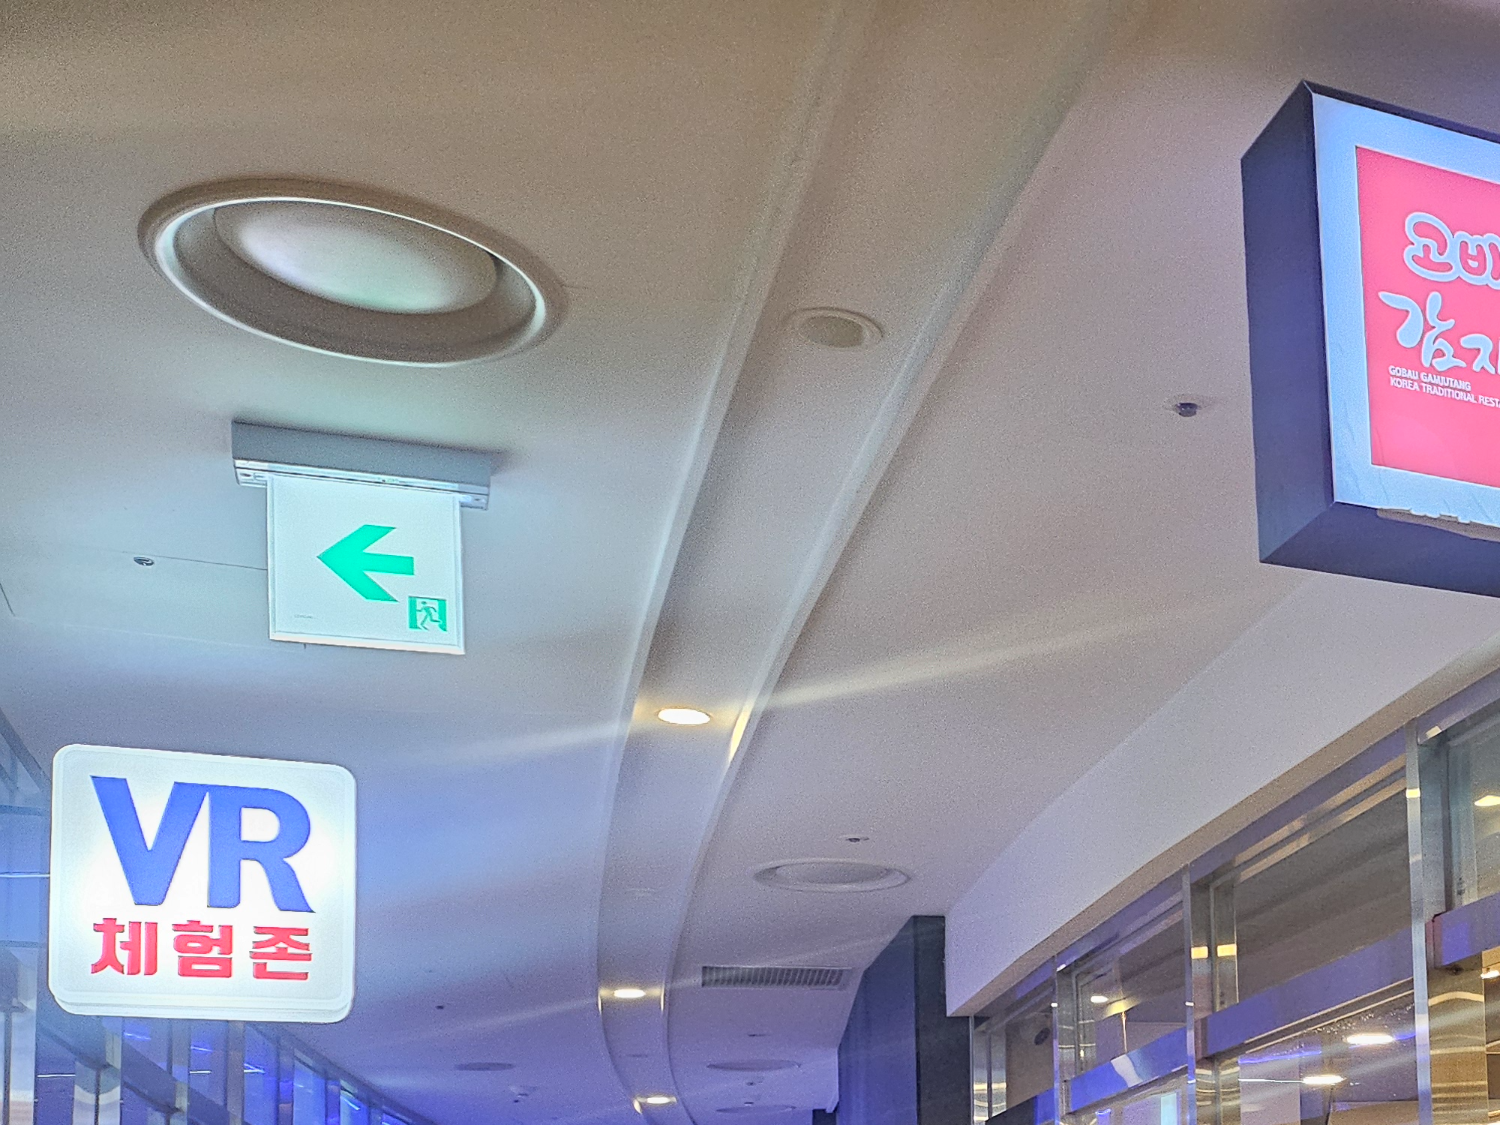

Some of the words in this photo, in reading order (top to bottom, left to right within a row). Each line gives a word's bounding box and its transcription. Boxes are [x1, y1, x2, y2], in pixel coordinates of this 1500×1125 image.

[1389, 366, 1420, 381] GOBAU
[1390, 376, 1421, 392] KOREA
[1421, 382, 1477, 404] TRADITIONAL
[91, 775, 314, 913] VR
[91, 917, 312, 980] 체험존
